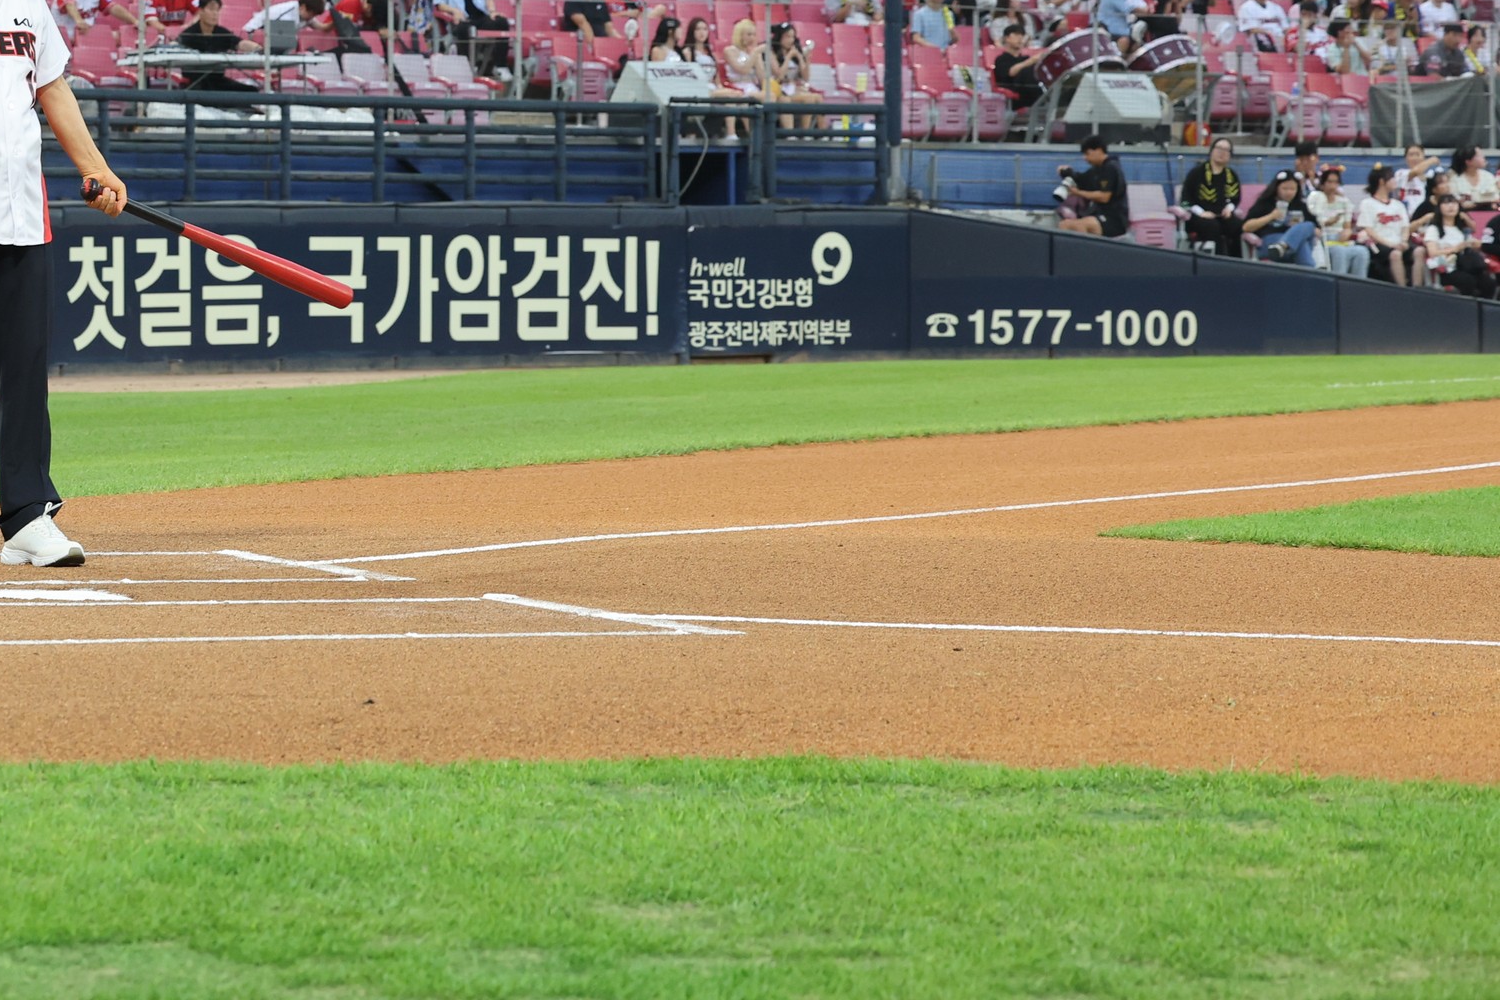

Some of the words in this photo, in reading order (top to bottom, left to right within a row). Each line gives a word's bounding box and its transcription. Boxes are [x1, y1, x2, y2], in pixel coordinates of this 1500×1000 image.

[67, 235, 281, 351] 첫걸음,
[308, 233, 660, 344] 국가암검진!
[968, 309, 1199, 347] 1577-1000
